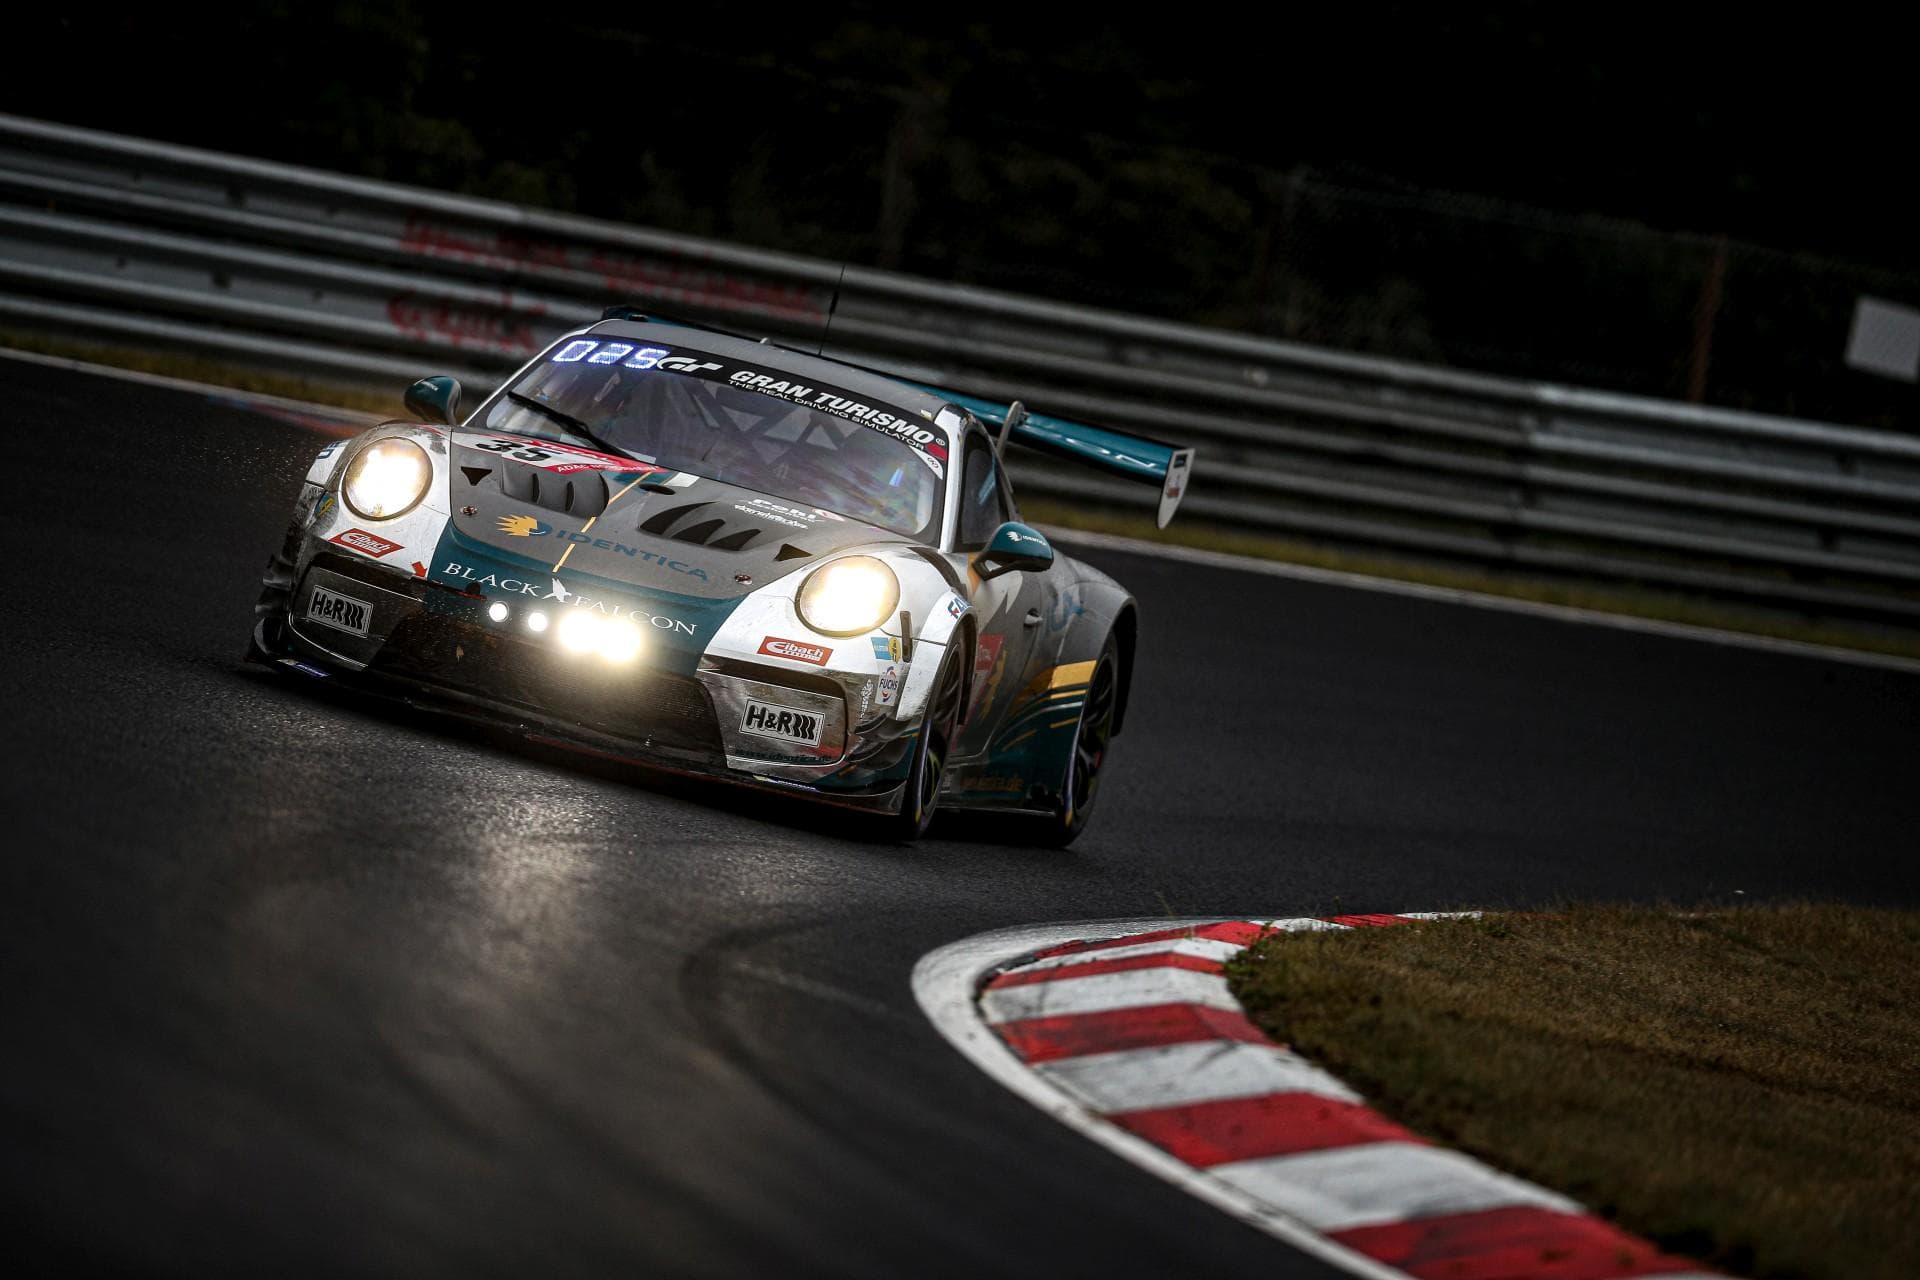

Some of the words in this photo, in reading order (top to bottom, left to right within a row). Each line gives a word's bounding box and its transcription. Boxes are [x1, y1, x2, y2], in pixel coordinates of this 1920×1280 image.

[552, 340, 670, 369] 025
[728, 379, 754, 391] THE
[757, 386, 793, 401] REAL
[794, 397, 850, 420] DRIVING
[851, 416, 926, 451] SIMULATOR
[730, 370, 813, 398] GRAN
[814, 392, 935, 444] TURISMO
[475, 439, 562, 462] 35
[555, 530, 709, 582] IDENTICA
[442, 562, 542, 597] BLACK
[573, 595, 698, 637] FALCON
[765, 640, 825, 658] Eibach
[879, 678, 899, 691] FUCHS
